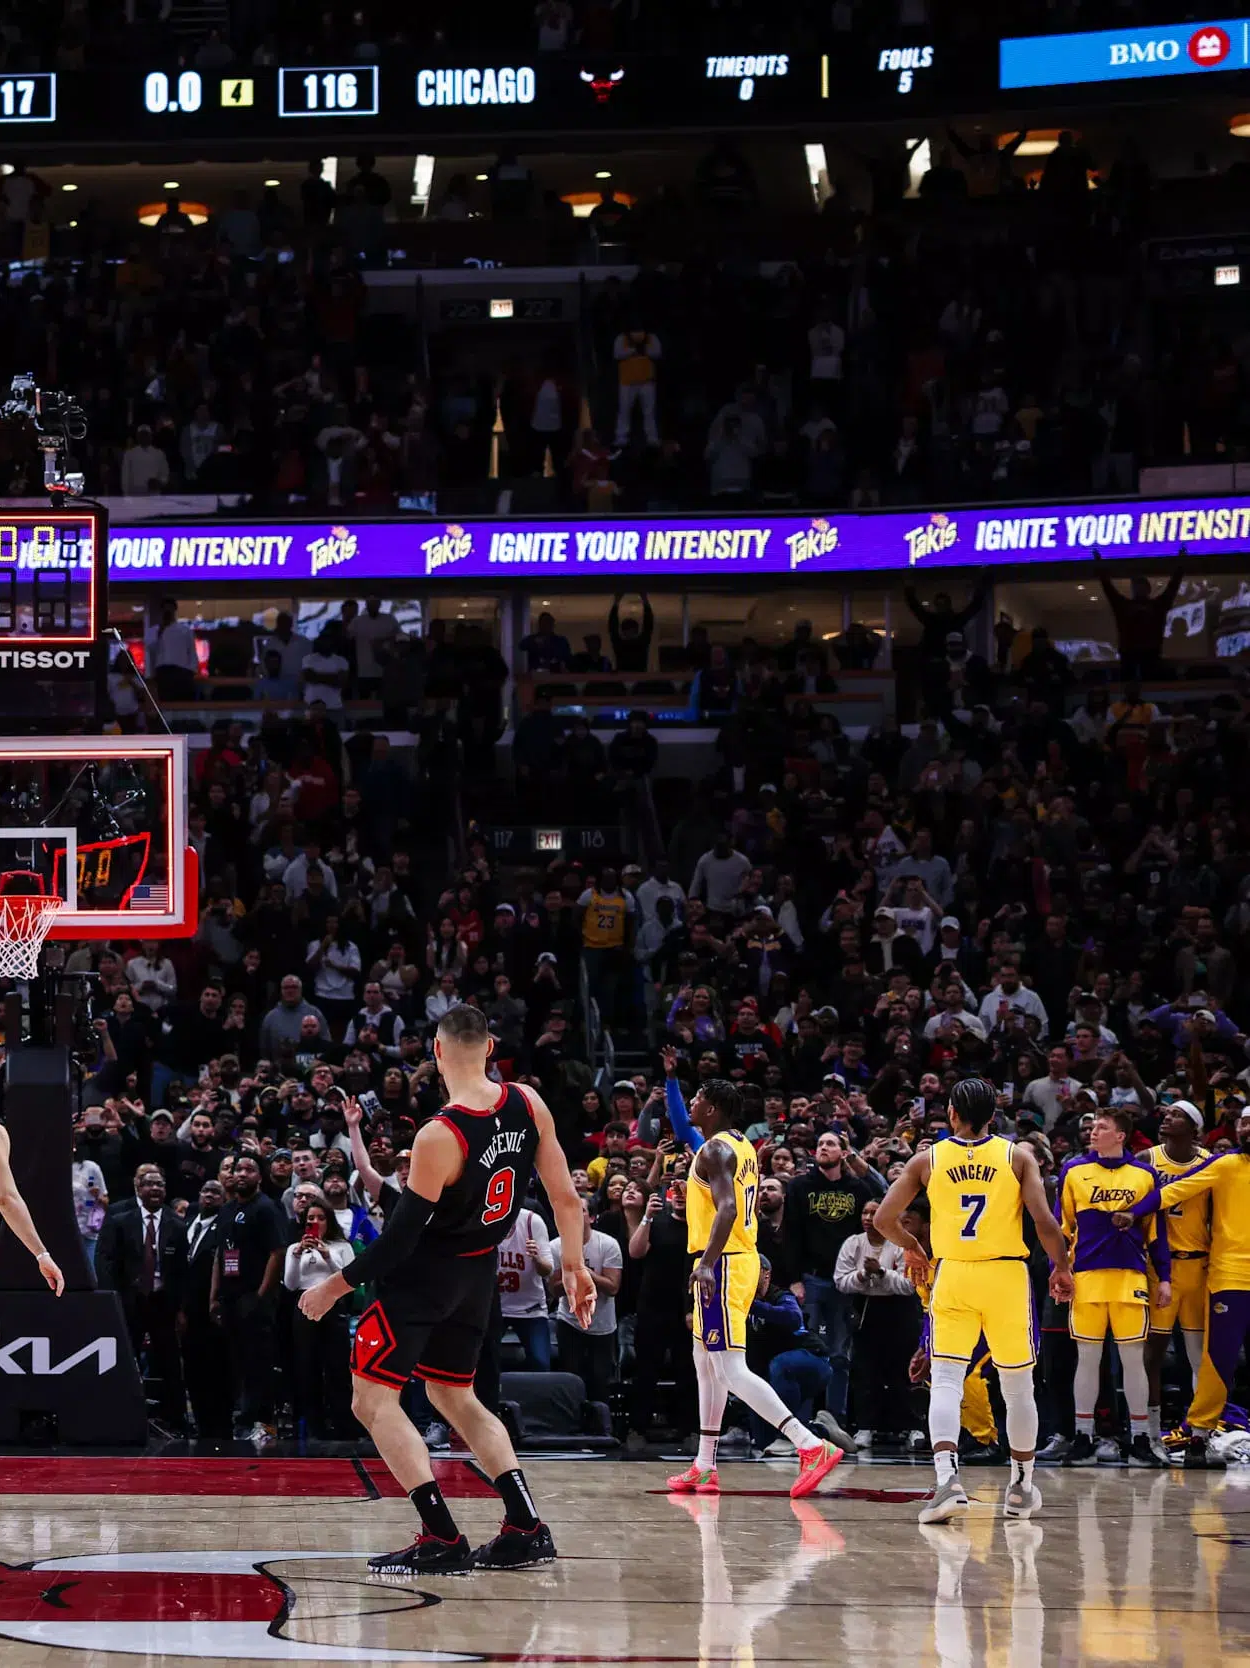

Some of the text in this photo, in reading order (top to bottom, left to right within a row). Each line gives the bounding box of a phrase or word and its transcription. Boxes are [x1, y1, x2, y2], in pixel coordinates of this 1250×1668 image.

[706, 55, 789, 78] TIMEOUTS
[878, 46, 933, 71] FOULS
[1109, 40, 1179, 65] BMO
[145, 72, 202, 113] 0.0
[303, 74, 358, 109] 116
[417, 68, 536, 106] CHICAGO
[738, 79, 753, 101] 0
[899, 71, 913, 93] 5
[489, 529, 771, 563] IGNITE YOUR INTENSITY
[903, 521, 960, 565] Takis
[975, 507, 1250, 551] IGNITE YOUR INTENSIT
[107, 537, 165, 568] YOUR
[170, 536, 293, 566] INTENSITY
[306, 533, 359, 576] Takis
[421, 532, 474, 575] Takis
[784, 525, 840, 569] Takis
[494, 830, 513, 849] 117
[538, 832, 559, 850] EXIT
[598, 914, 615, 929] 23
[479, 1128, 527, 1170] VUČEVIĆ
[946, 1164, 998, 1184] VINCENT
[481, 1166, 516, 1226] 9
[1090, 1185, 1137, 1205] LAKERS
[959, 1194, 987, 1241] 7
[498, 1252, 526, 1269] LLS
